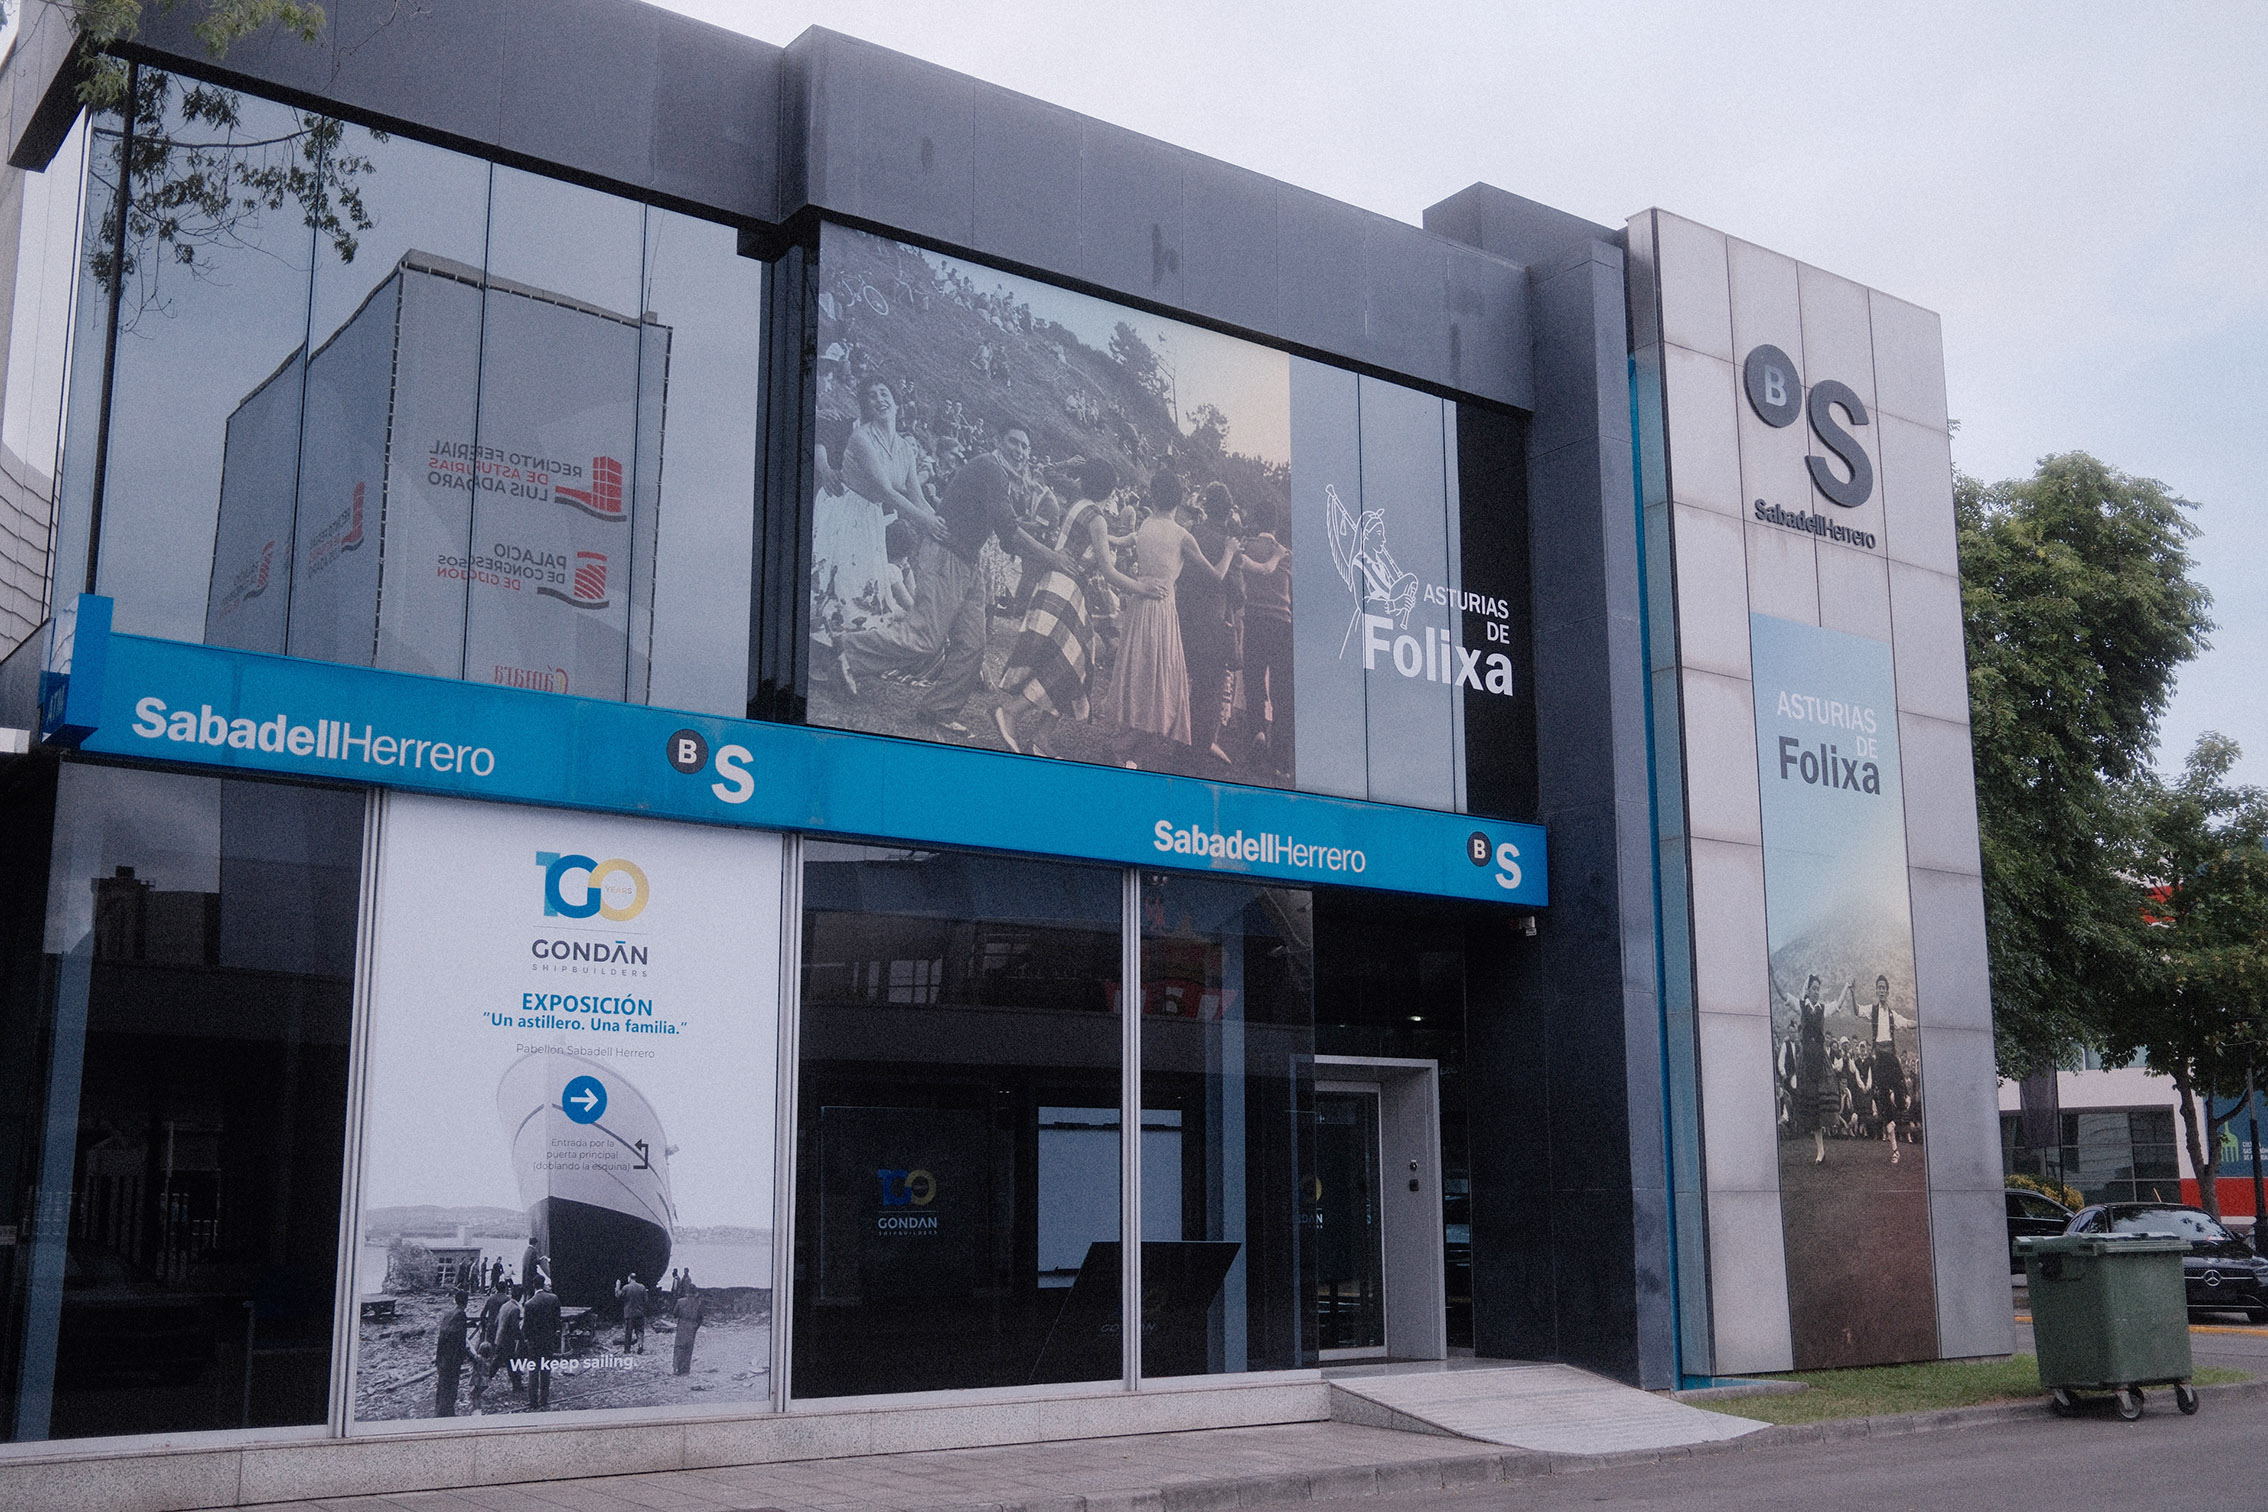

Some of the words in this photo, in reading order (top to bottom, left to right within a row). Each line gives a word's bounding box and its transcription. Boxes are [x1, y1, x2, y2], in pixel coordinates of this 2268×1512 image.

[1754, 498, 1876, 549] SabadellHerrero
[1423, 583, 1510, 619] ASTURIAS
[1486, 621, 1510, 645] DE
[1361, 612, 1514, 697] Folixa
[1777, 690, 1877, 733] ASTURIAS
[132, 696, 495, 776] SabadellHerrero
[1855, 735, 1879, 760] DE
[1778, 735, 1880, 795] Folixa
[1153, 819, 1366, 873] SabadellHerrero
[604, 885, 633, 895] YEARS
[531, 963, 648, 978] SHIPBUILDERS
[521, 993, 653, 1017] EXPOSICIÓN
[517, 1015, 585, 1031] astillero.
[590, 1018, 620, 1032] Una
[516, 1043, 564, 1056] Pabellón
[567, 1045, 613, 1057] Sabadell
[615, 1047, 656, 1059] Herrero
[546, 1151, 577, 1160] puerta
[579, 1151, 619, 1160] principal
[551, 1138, 587, 1147] Entrada
[589, 1140, 605, 1149] por
[606, 1139, 615, 1148] la
[533, 1162, 580, 1171] (doblando
[582, 1162, 590, 1171] la
[592, 1163, 631, 1172] esquina)
[509, 1358, 537, 1372] We
[540, 1356, 580, 1372] keep
[582, 1354, 638, 1370] sailing.
